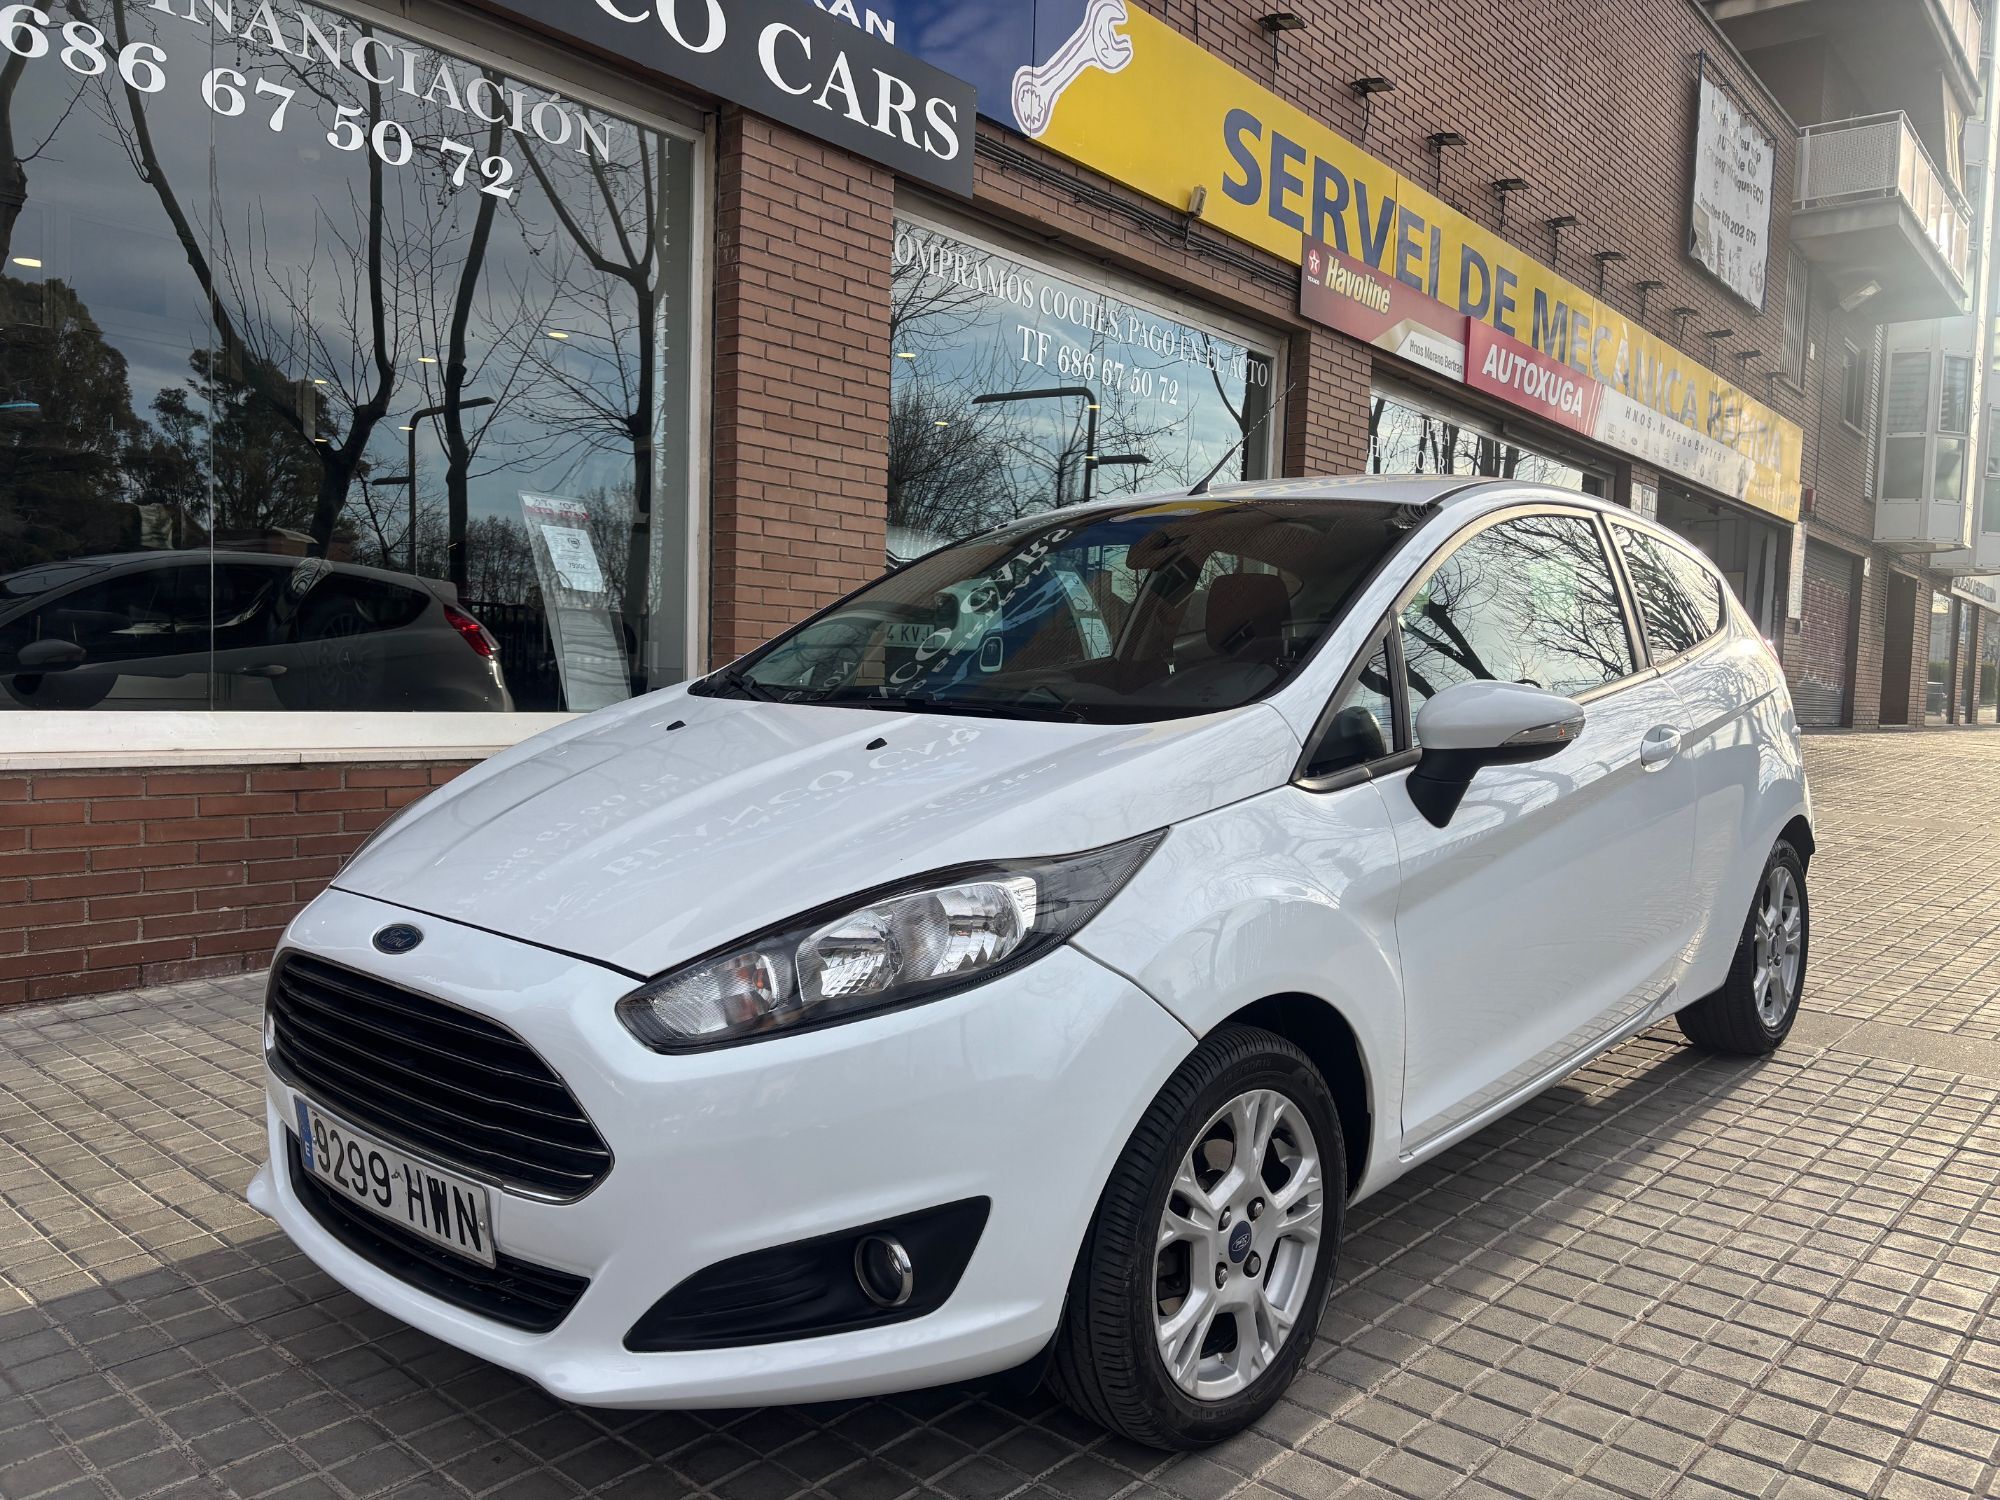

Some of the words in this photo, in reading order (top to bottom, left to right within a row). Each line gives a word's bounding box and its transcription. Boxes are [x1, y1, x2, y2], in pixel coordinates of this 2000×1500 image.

[813, 0, 896, 46] AN
[0, 4, 168, 93] 686
[200, 67, 296, 132] 67
[326, 107, 414, 166] 50
[439, 137, 516, 200] 72
[757, 21, 961, 161] CARS
[1730, 220, 1745, 239] 202
[1222, 108, 1441, 301] SERVEI
[1458, 243, 1518, 338] DE
[1532, 287, 1698, 432] MECÀNICA
[1325, 254, 1392, 315] Havoline
[889, 233, 1035, 309] OMPRAMOS
[1039, 286, 1125, 345] COCHES,
[1127, 316, 1175, 356] PAGO
[1180, 335, 1201, 365] EN
[1206, 344, 1225, 374] EL
[1229, 353, 1268, 387] ACTO
[1016, 324, 1052, 367] TF
[1057, 345, 1095, 380] 686
[1102, 359, 1125, 390] 67
[1130, 367, 1153, 397] 50
[1158, 376, 1179, 406] 72
[1409, 339, 1424, 357] Hnos
[1424, 347, 1444, 366] Moreno
[1481, 343, 1584, 418] AUTOXUGA
[1659, 421, 1692, 448] Moreno
[303, 1141, 313, 1158] E
[314, 1118, 393, 1209] 9299
